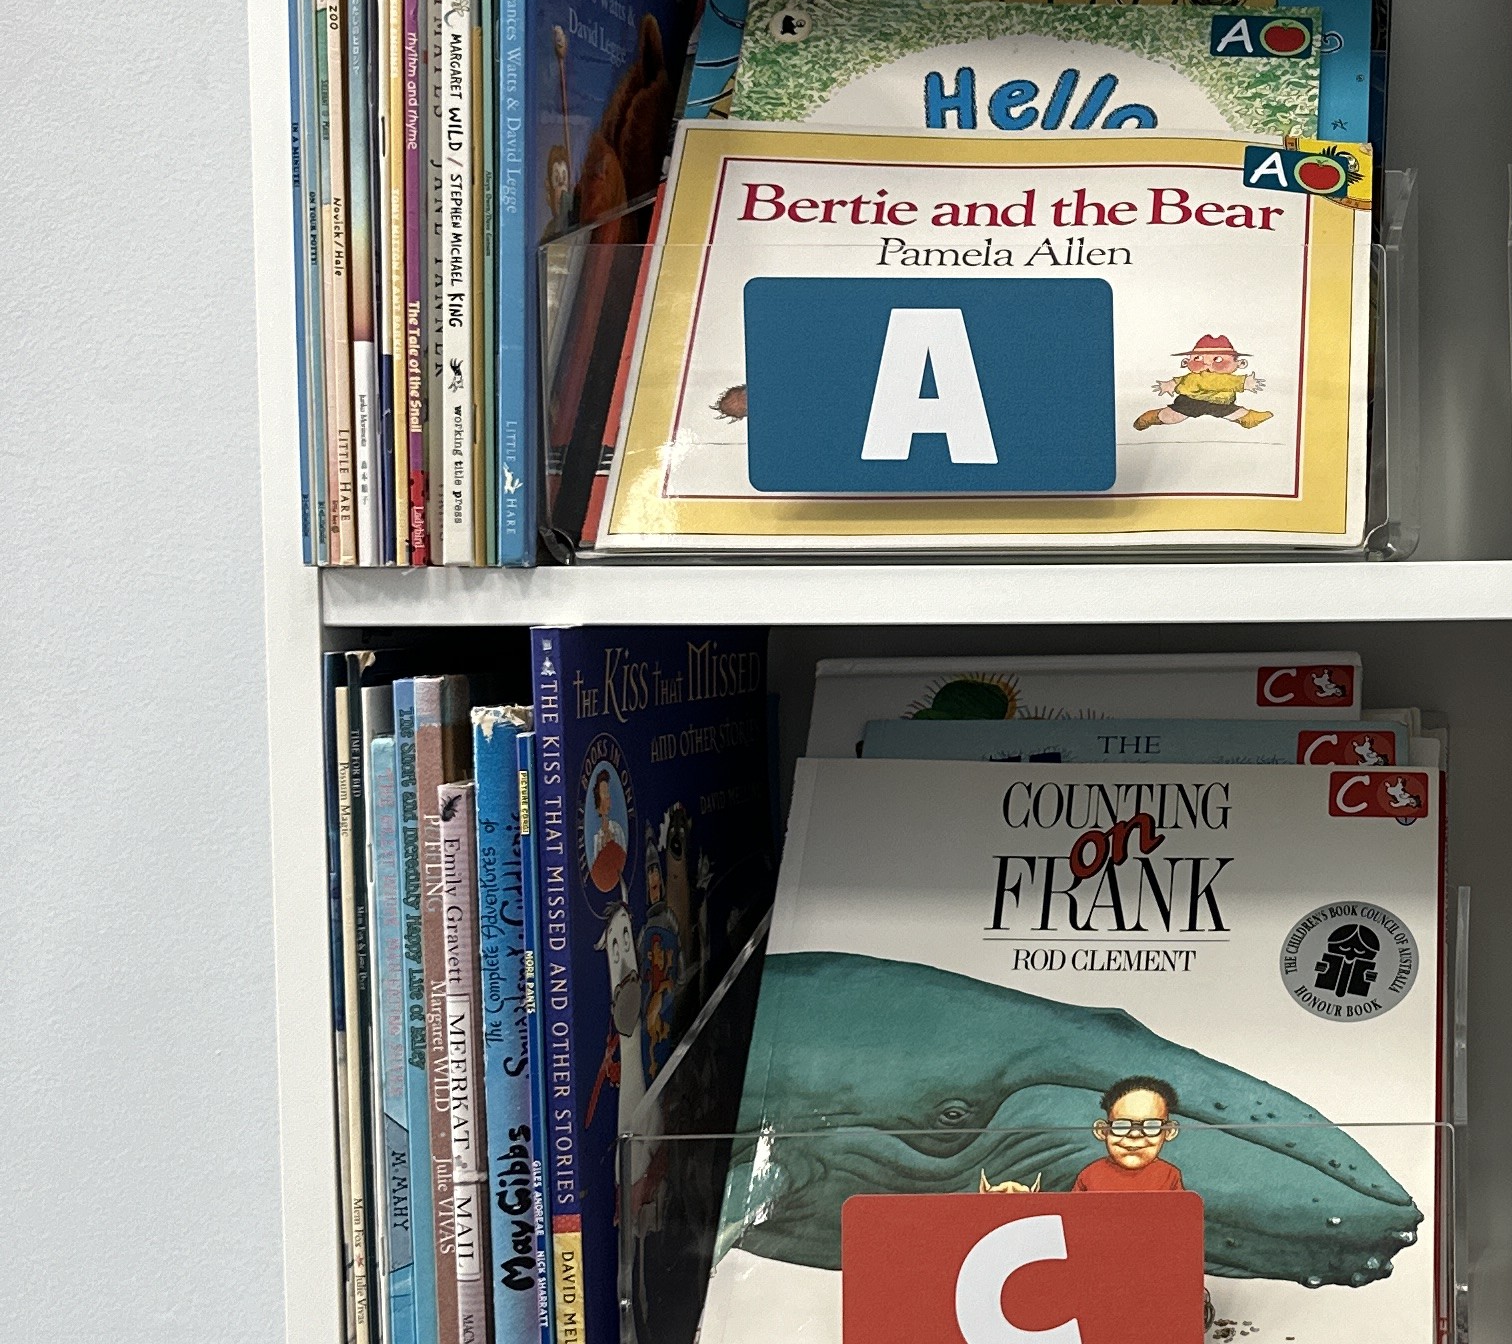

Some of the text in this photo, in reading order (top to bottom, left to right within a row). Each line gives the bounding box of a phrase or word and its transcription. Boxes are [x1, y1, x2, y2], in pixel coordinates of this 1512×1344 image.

[329, 5, 338, 30] ZOO
[1216, 18, 1253, 54] A
[506, 47, 521, 92] Watts
[506, 97, 520, 110] &
[507, 117, 522, 162] David
[503, 168, 522, 213] Legge
[1249, 153, 1285, 187] A
[738, 184, 1284, 231] Bertie and the Bear
[877, 236, 1133, 268] Pamela Allen
[861, 307, 998, 465] A
[1097, 735, 1160, 753] THE
[1002, 782, 1233, 830] COUNTING
[1335, 776, 1369, 812] C
[1069, 812, 1165, 879] on
[442, 839, 464, 983] Emily Gravett
[984, 856, 1235, 932] FRANK
[541, 680, 574, 1204] THE KISS THAT MISSED AND OTHER STORIES
[1012, 949, 1197, 971] ROD CLEMENT
[1294, 985, 1382, 1017] HONOUR BOOK
[427, 980, 449, 1112] Margaret WILD
[449, 1013, 471, 1149] MEERKAT
[433, 1155, 455, 1254] Julie VIVAS
[497, 1125, 536, 1292] May Gibbs
[456, 1196, 474, 1268] MAIL
[561, 1251, 576, 1304] DAVID
